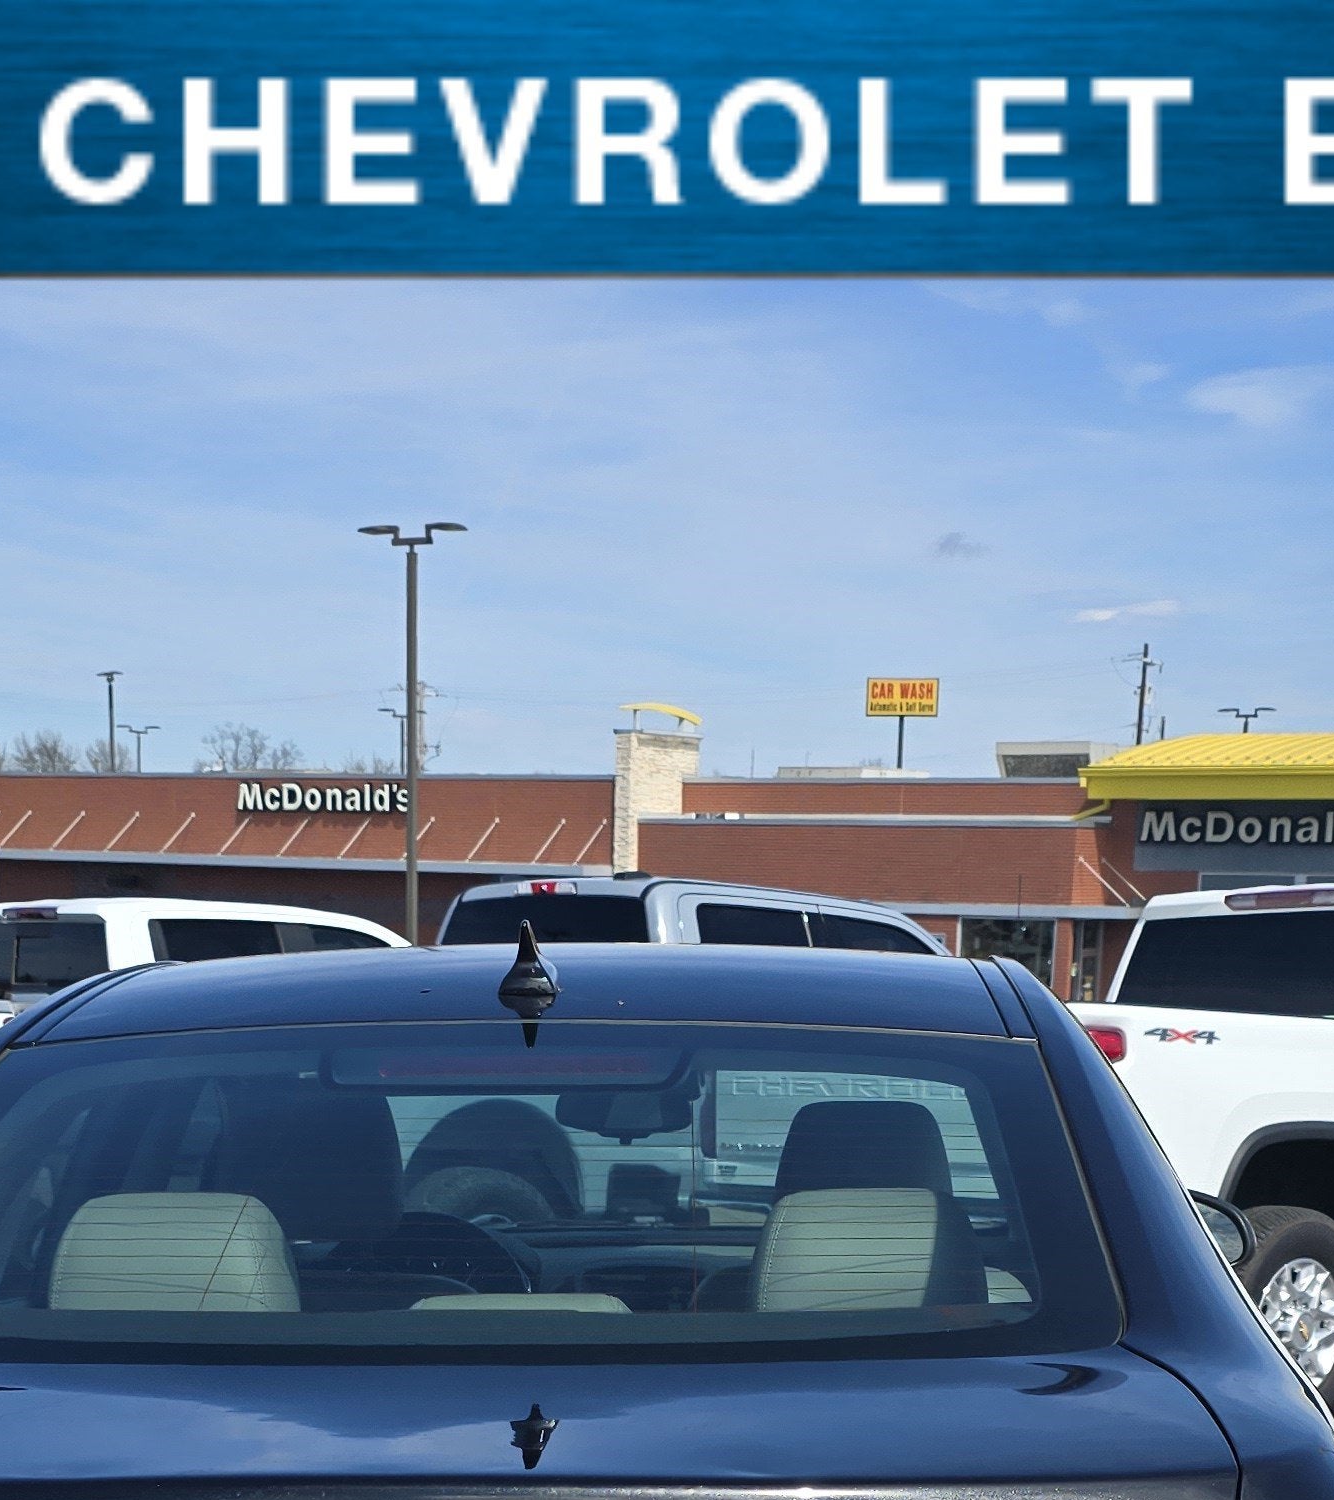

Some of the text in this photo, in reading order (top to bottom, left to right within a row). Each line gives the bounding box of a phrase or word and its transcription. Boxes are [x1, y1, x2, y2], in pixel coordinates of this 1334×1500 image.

[871, 682, 934, 700] CAR WASH
[237, 782, 409, 812] McDonald's
